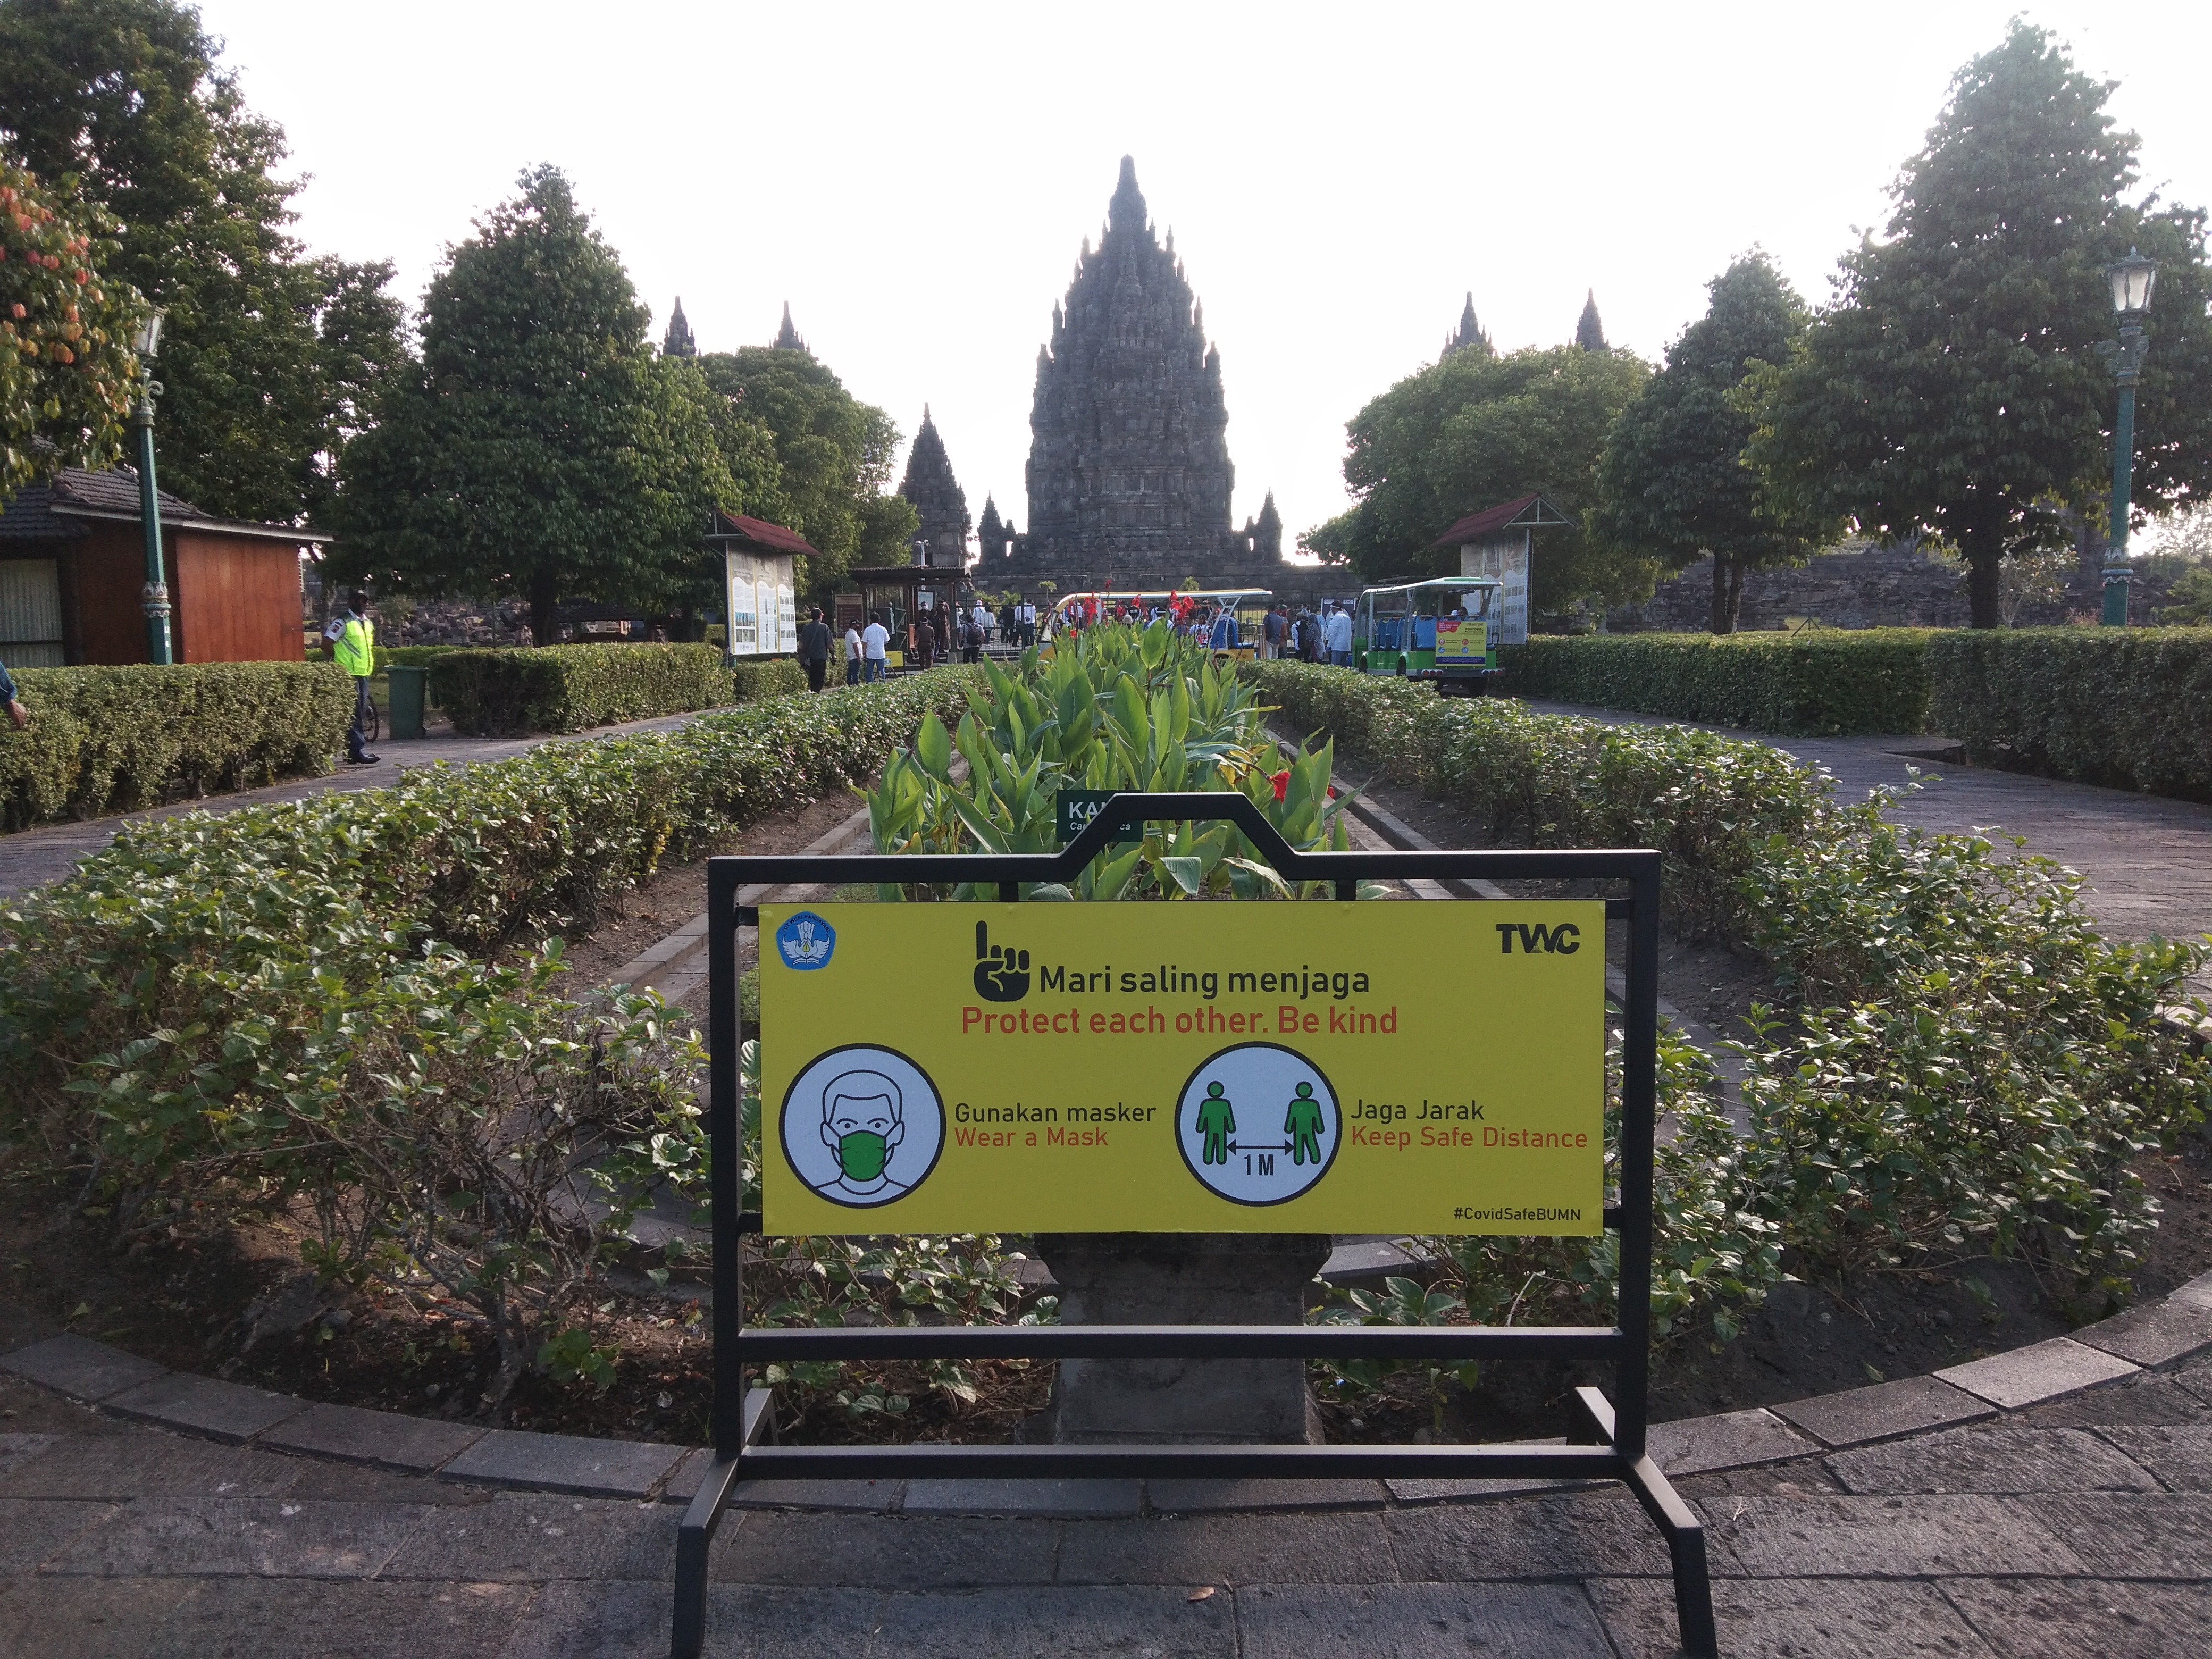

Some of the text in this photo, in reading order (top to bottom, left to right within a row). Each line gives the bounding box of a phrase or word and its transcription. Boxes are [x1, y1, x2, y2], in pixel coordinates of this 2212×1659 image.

[1069, 801, 1107, 818] KA
[1496, 923, 1580, 954] TWC
[1041, 965, 1370, 1001] Mari saling menjaga
[962, 1006, 1398, 1034] Protect each other. Be kind
[956, 1102, 1157, 1123] Gunakan masker
[1351, 1099, 1485, 1125] Jaga Jarak
[954, 1126, 1109, 1147] Wear a Mask
[1352, 1126, 1588, 1152] Keep Safe Distance
[1244, 1154, 1275, 1176] 1 M
[1453, 1207, 1581, 1222] #CovidSafeBUMN
